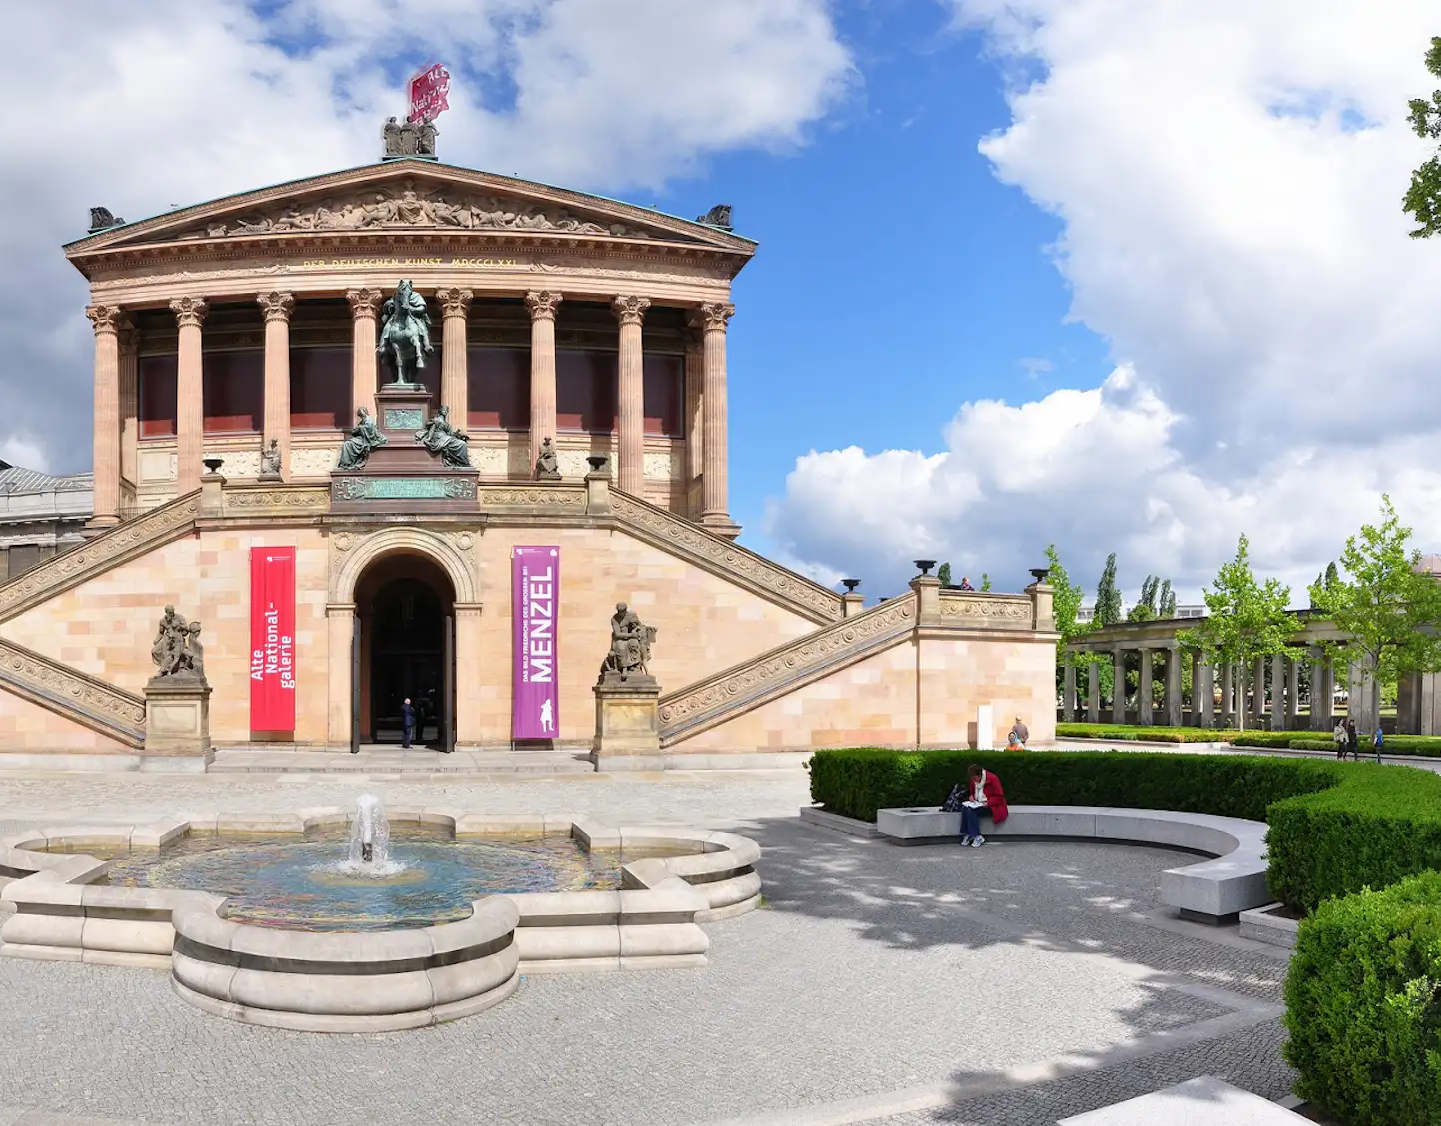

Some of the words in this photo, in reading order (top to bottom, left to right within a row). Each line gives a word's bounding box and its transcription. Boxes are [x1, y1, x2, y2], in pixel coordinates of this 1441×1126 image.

[303, 260, 325, 268] DER
[332, 258, 399, 268] DEUTSCHEN
[404, 257, 442, 266] KUNST
[265, 602, 279, 674] National-
[530, 566, 552, 682] MENZEL
[251, 649, 264, 681] Alte
[279, 635, 295, 689] galerie
